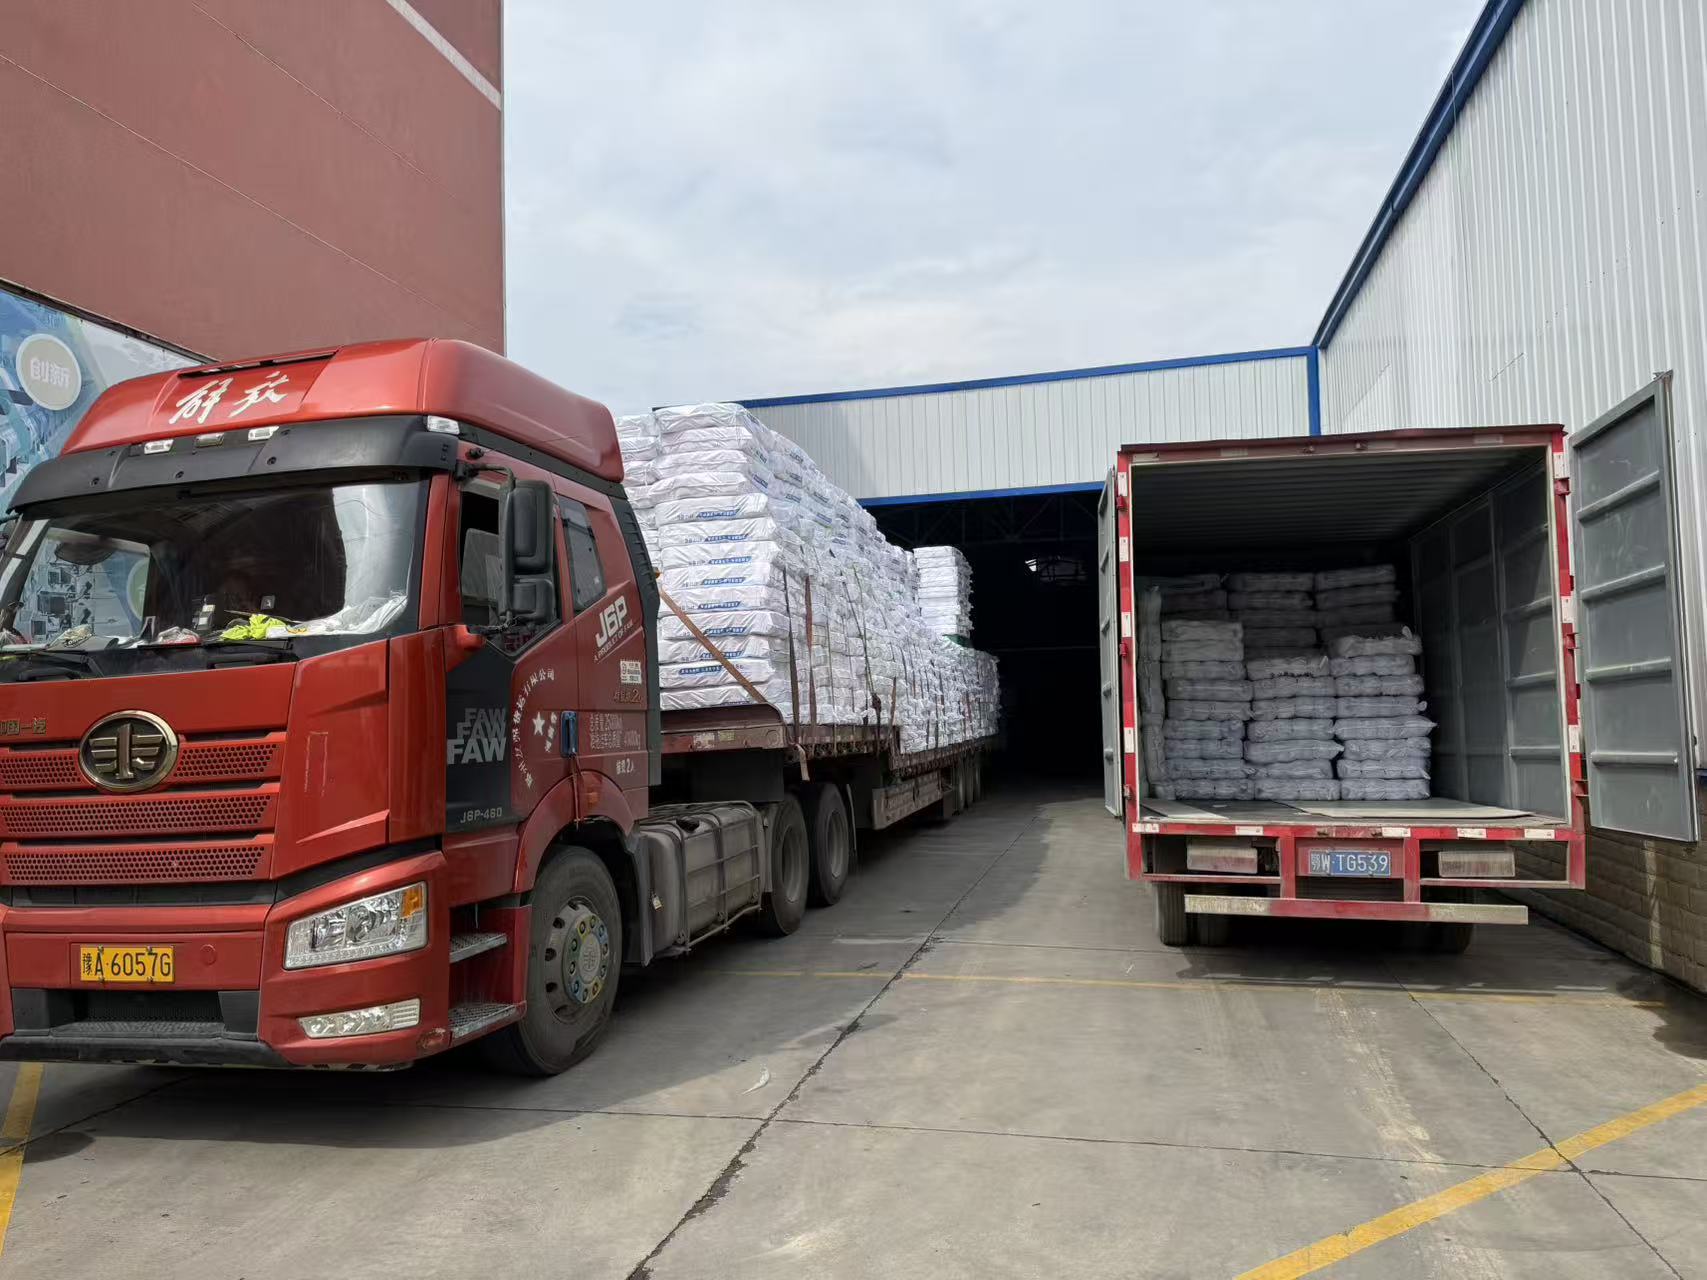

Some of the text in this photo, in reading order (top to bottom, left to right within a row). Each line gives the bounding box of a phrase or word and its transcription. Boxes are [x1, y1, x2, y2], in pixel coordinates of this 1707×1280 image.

[169, 371, 289, 424] 解放
[595, 595, 627, 648] J6P
[465, 707, 506, 724] FAW
[456, 721, 506, 742] FAW
[446, 738, 506, 764] FAW
